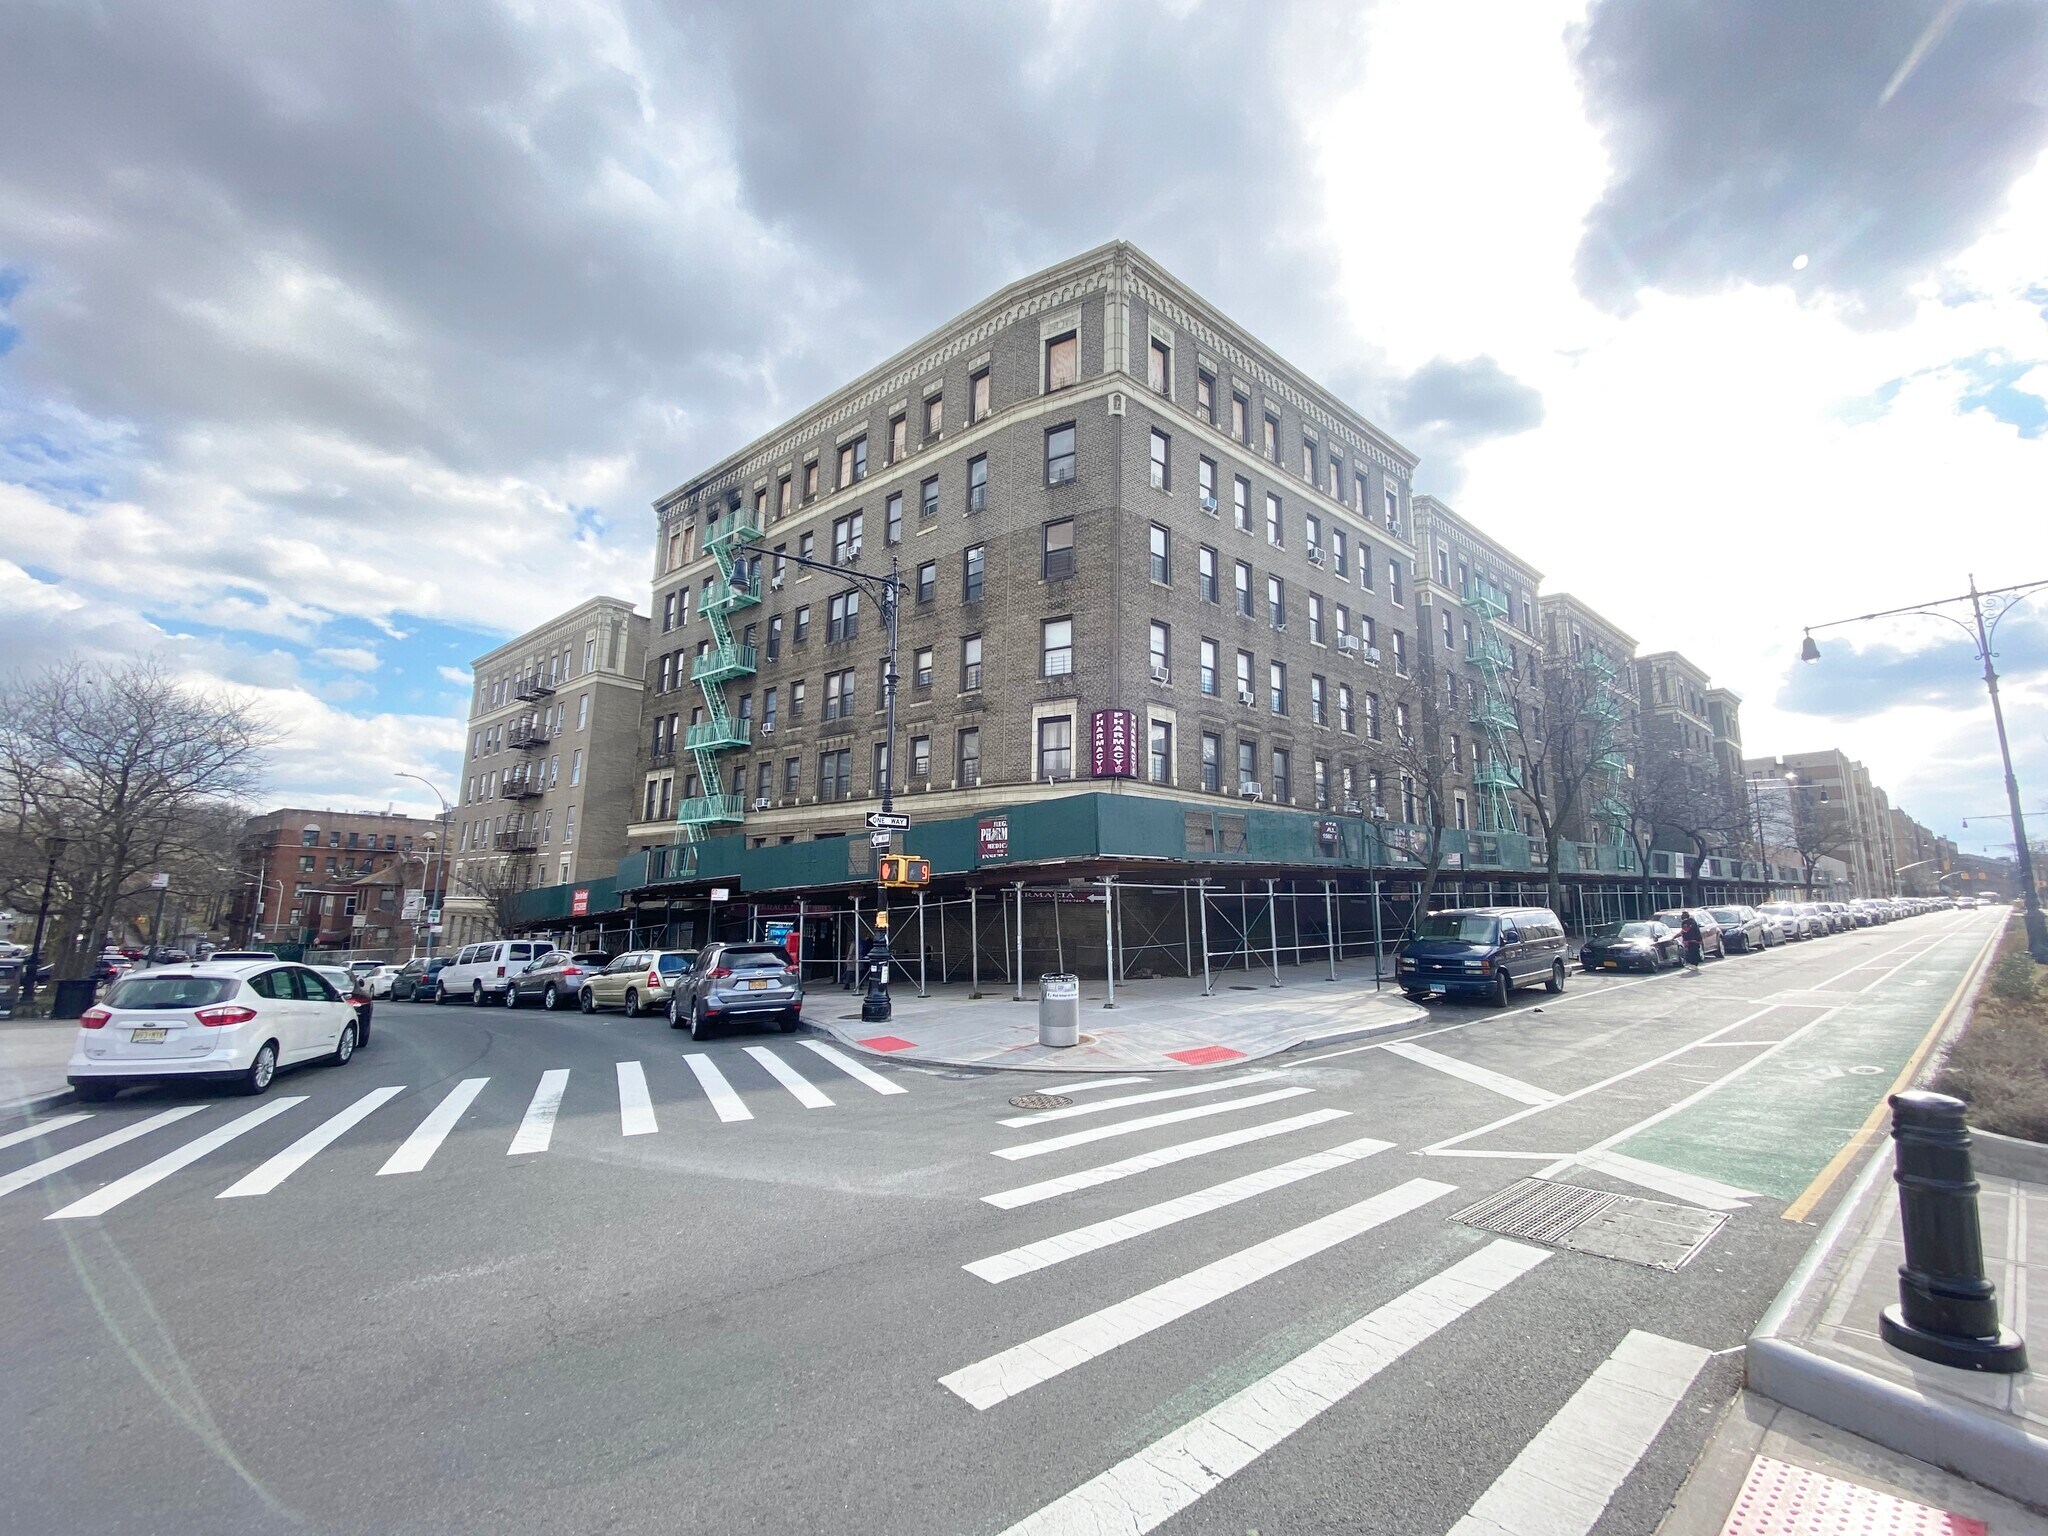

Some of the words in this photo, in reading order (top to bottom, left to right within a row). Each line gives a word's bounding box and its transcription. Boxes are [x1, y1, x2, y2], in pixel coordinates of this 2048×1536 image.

[1095, 713, 1104, 766] PHARMACY
[1112, 712, 1125, 765] PHARMACY
[872, 816, 885, 824] ONE
[921, 865, 928, 880] 9
